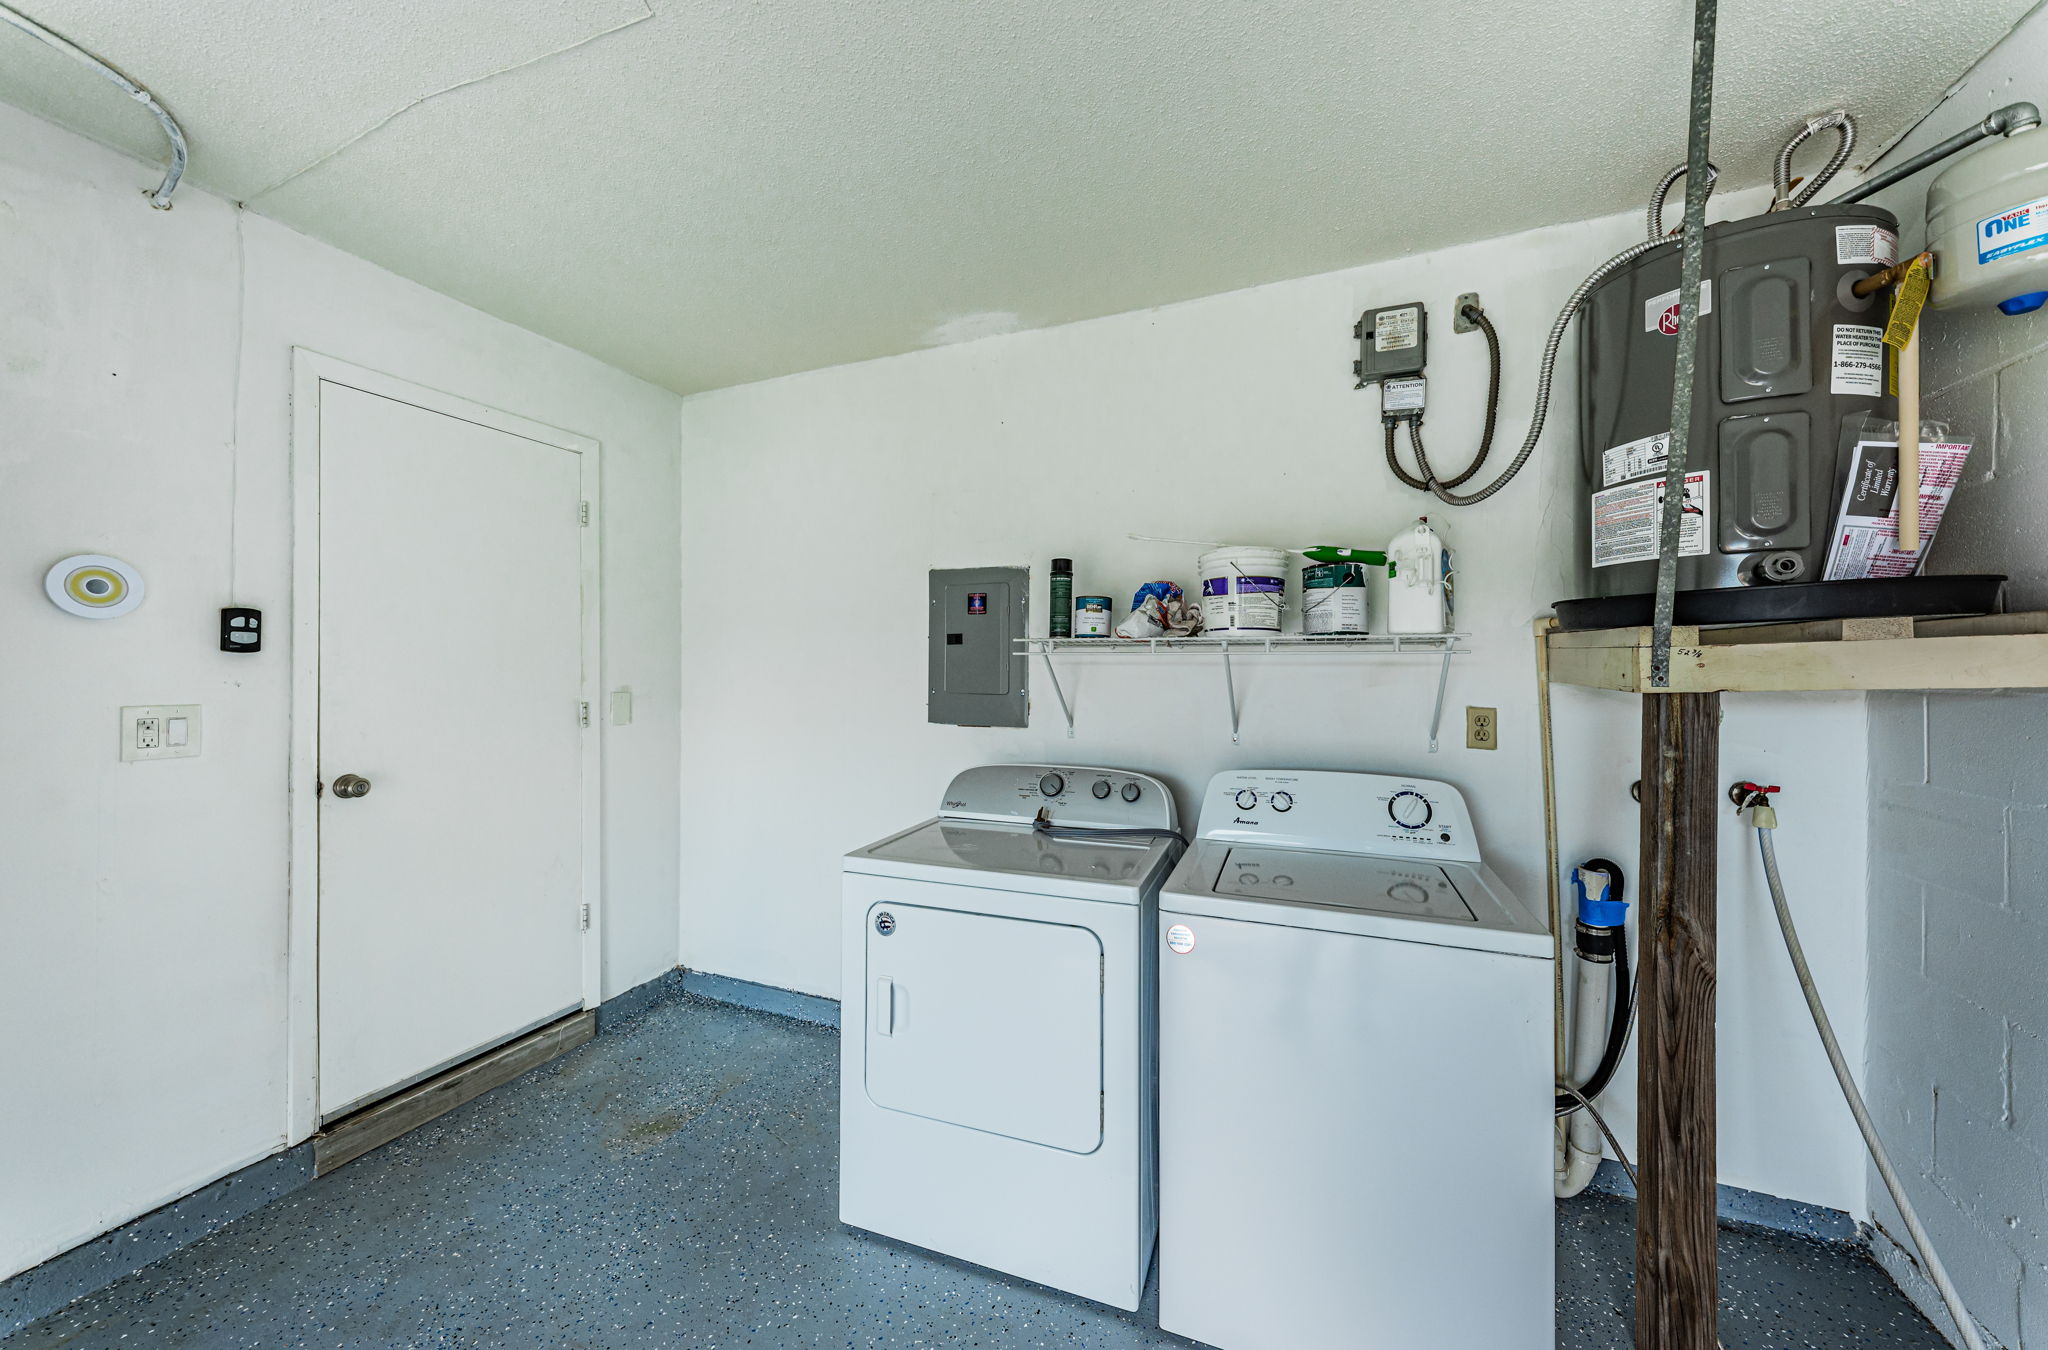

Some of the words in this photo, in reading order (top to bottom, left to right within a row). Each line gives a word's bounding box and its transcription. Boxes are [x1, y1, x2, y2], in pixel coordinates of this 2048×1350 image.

[1985, 214, 2030, 238] ONE
[1834, 361, 1881, 370] 1-866-279-4566
[1392, 382, 1423, 390] ATTENTION
[1857, 465, 1873, 501] Certificate
[1866, 459, 1876, 468] of
[1871, 469, 1883, 493] Limited
[1880, 467, 1896, 496] Warranty
[1233, 816, 1259, 825] Amana
